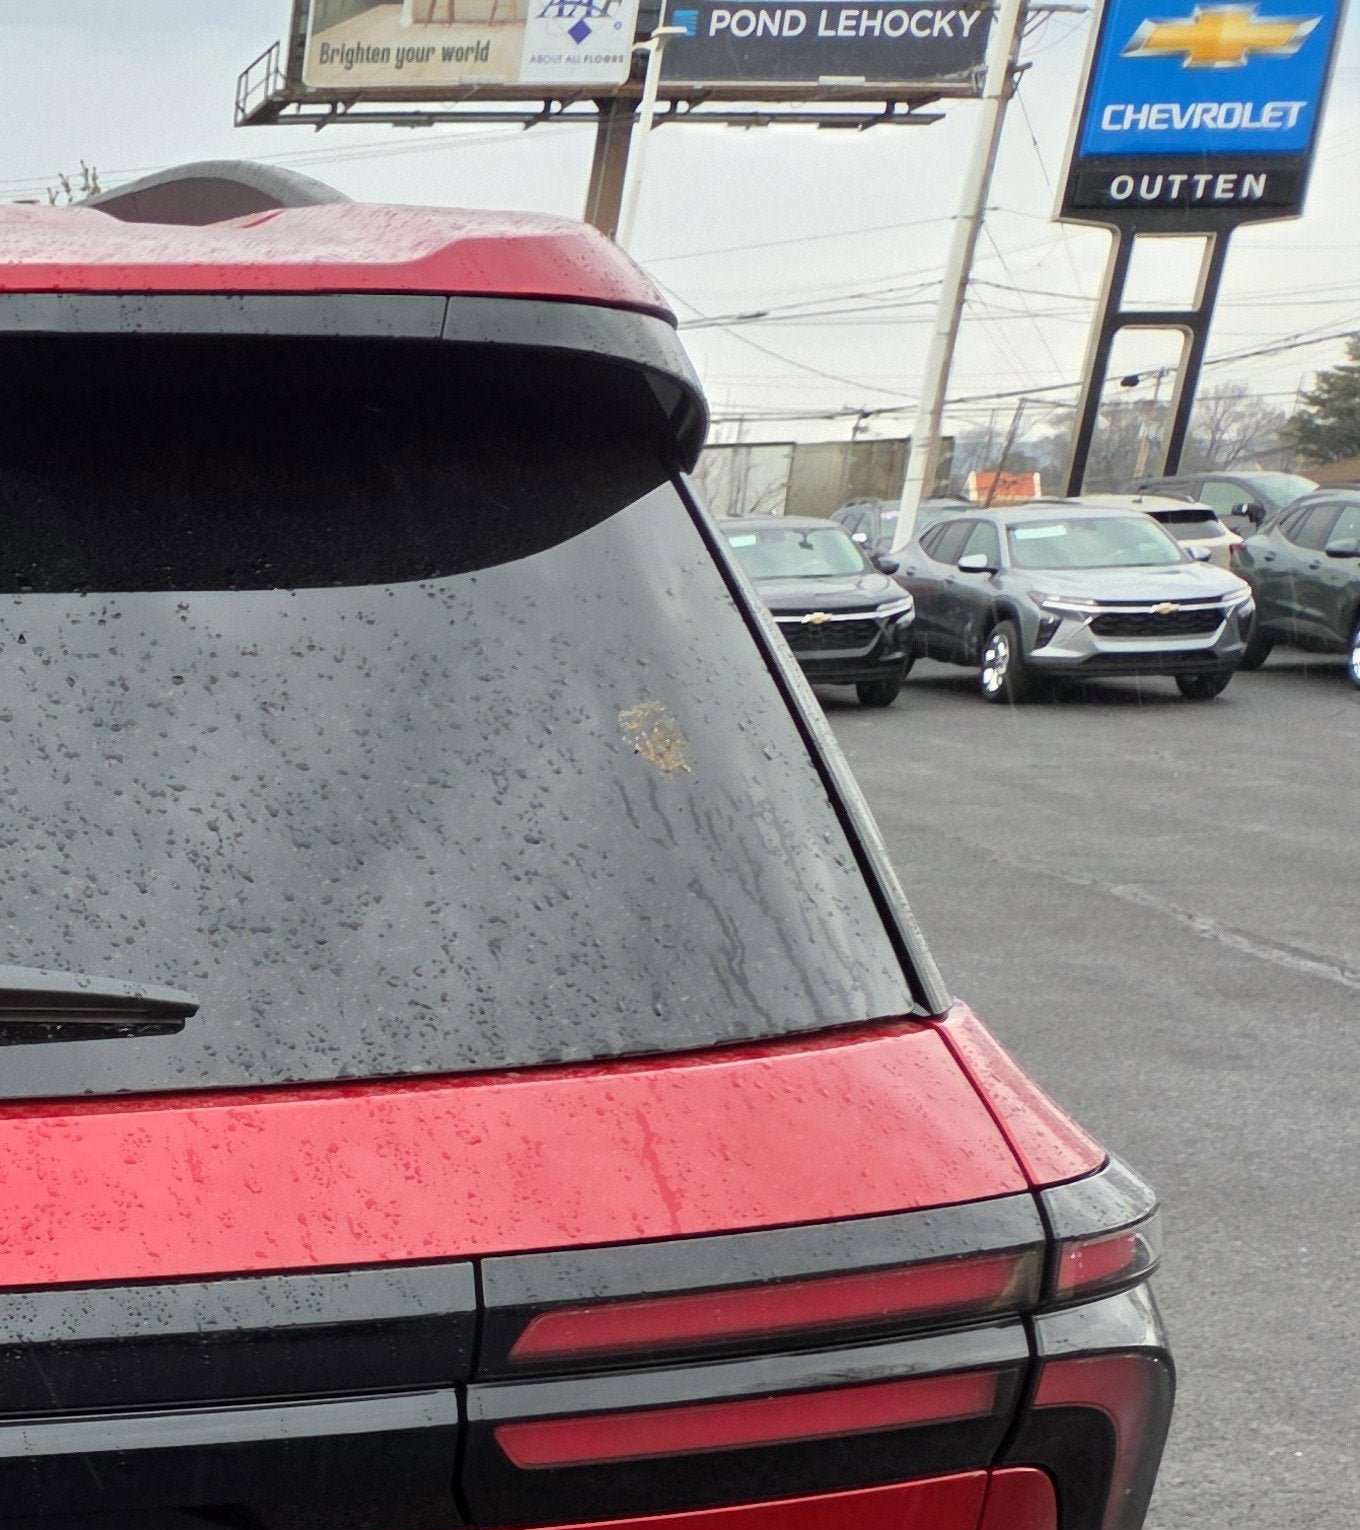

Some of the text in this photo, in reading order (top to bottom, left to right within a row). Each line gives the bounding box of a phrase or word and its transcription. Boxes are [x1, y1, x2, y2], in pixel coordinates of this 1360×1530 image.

[709, 9, 981, 37] POND LEHOCKY
[319, 40, 491, 70] Brighten your world
[529, 54, 562, 64] ABOUT
[1101, 101, 1307, 131] CHEVROLET
[1110, 173, 1267, 200] OUTTEN
